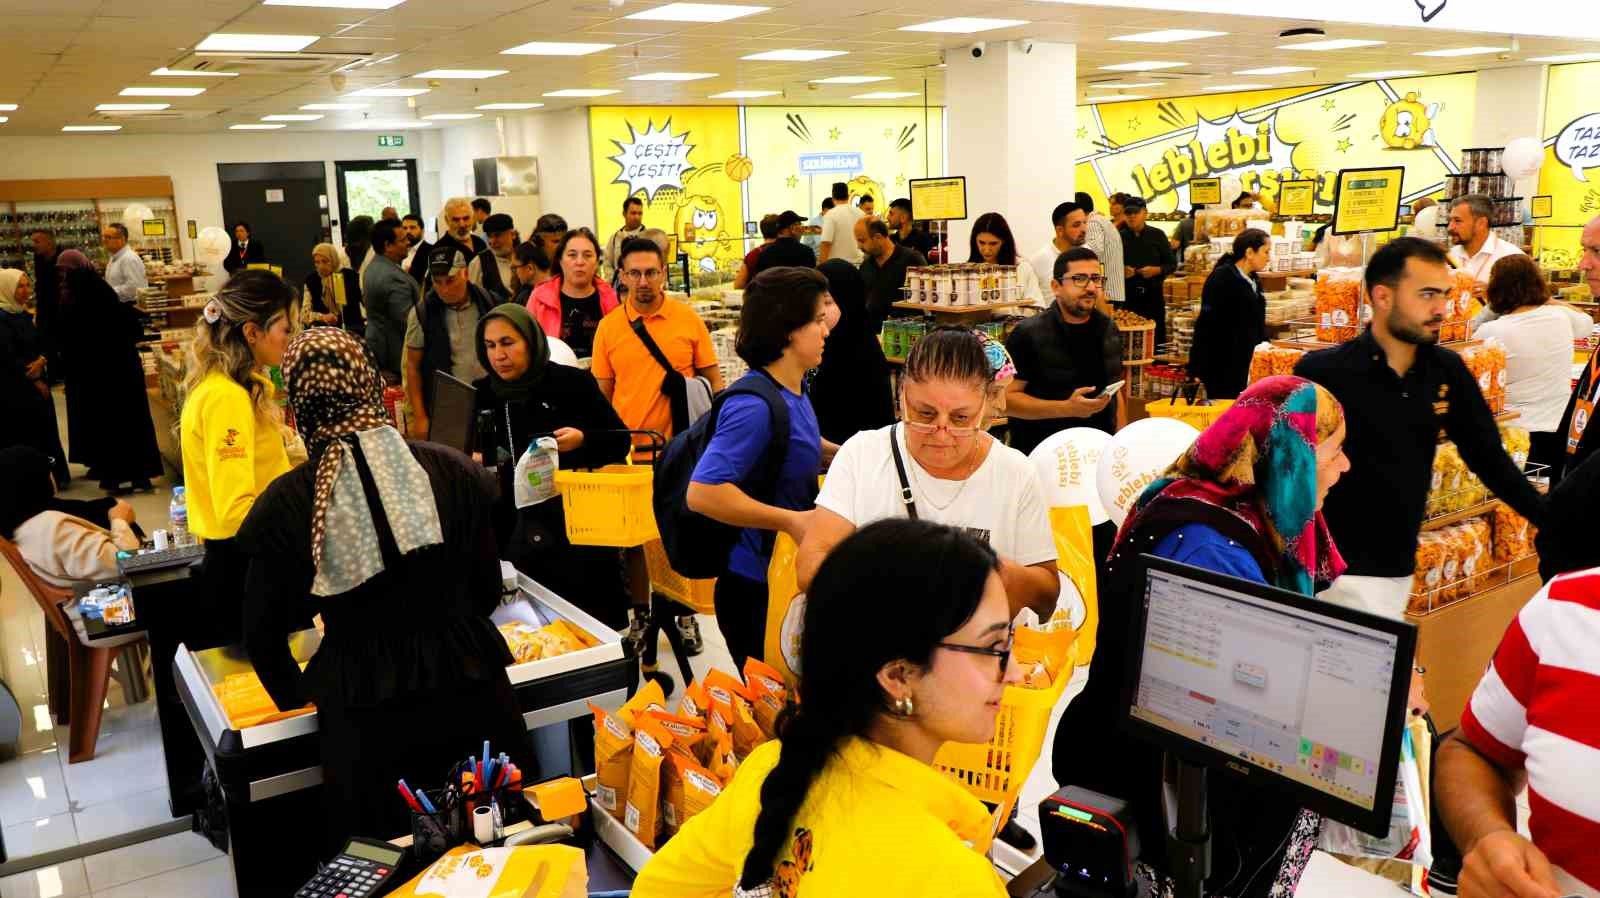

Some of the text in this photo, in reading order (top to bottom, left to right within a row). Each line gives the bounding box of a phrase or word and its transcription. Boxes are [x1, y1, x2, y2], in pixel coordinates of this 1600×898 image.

[634, 139, 682, 159] ÇEŞİT
[628, 160, 682, 179] ÇEŞİT!
[1132, 121, 1272, 201] leblebi
